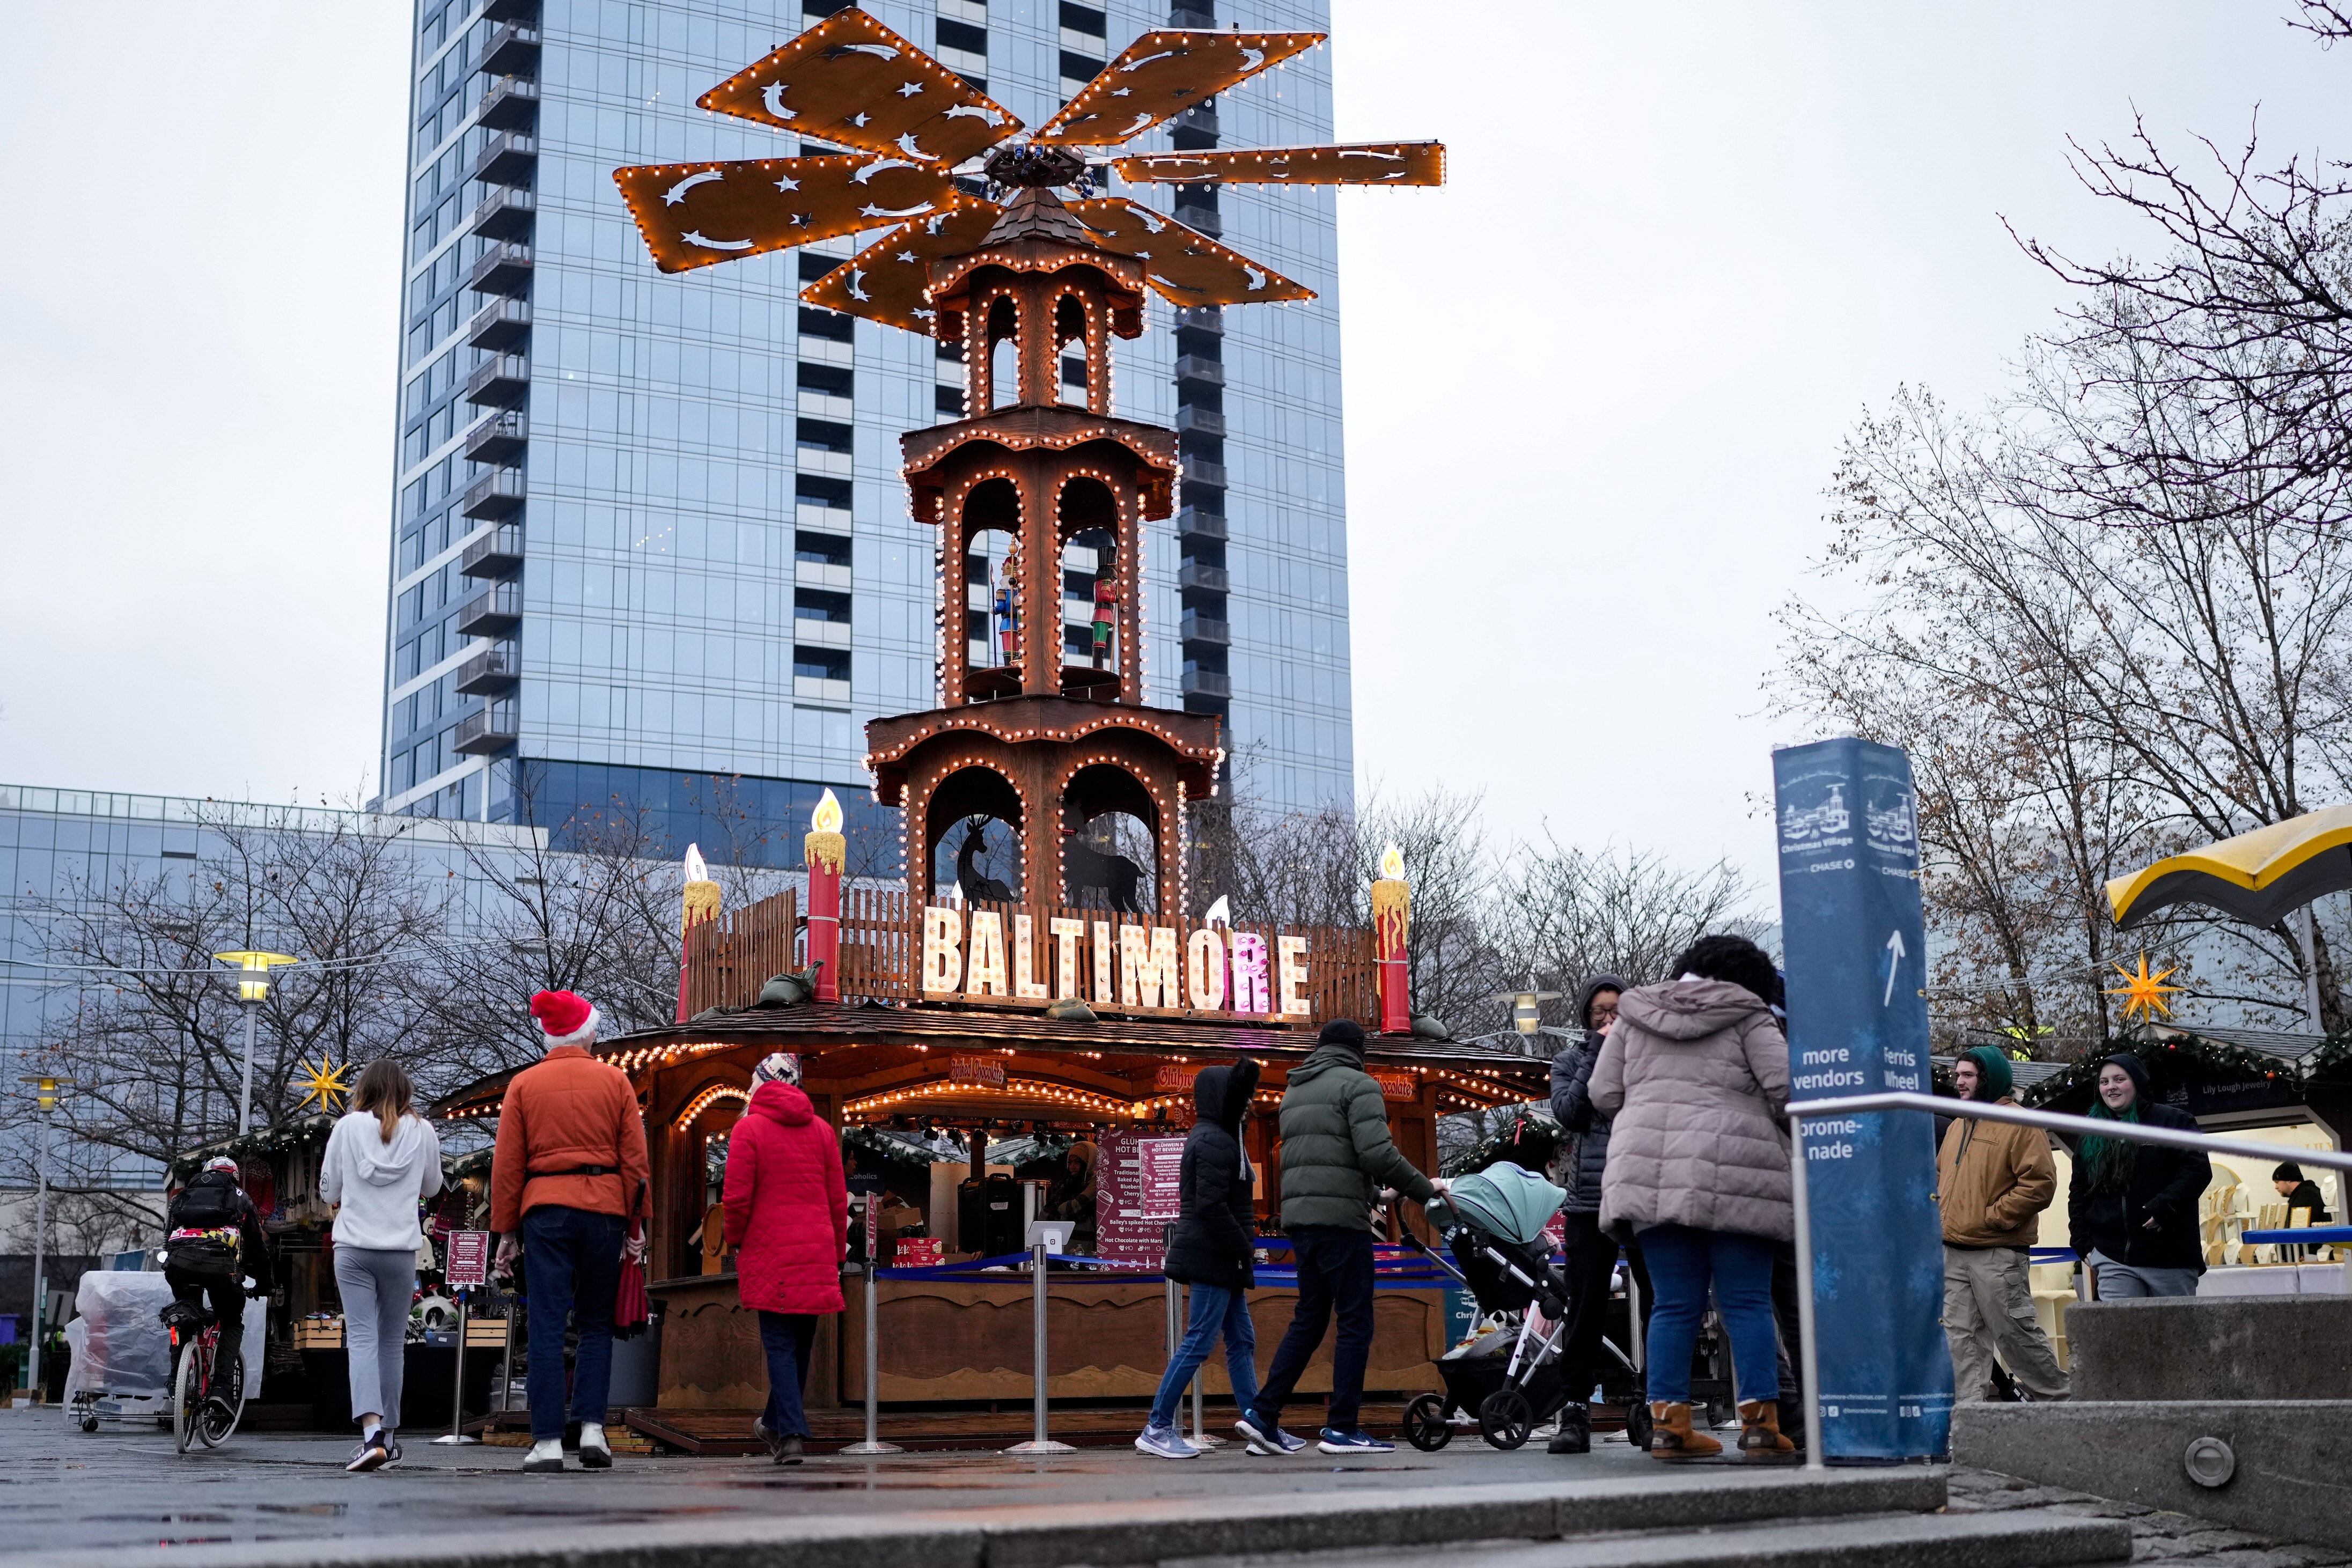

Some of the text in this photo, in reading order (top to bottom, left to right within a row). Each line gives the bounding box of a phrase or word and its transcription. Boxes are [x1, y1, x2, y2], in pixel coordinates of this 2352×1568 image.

[1781, 842, 1822, 853] Christmas
[1822, 837, 1853, 846] Village
[1810, 860, 1843, 873] CHASE
[1881, 867, 1907, 878] CHASE
[922, 906, 1311, 1015] BALTIMORE
[1803, 1048, 1849, 1065] more
[1884, 1046, 1916, 1067] Ferris
[951, 1057, 1004, 1084] Spiked Chocolate
[1792, 1069, 1864, 1089] vendors
[1884, 1070, 1919, 1090] Wheel
[2203, 1080, 2270, 1094] Lily Lough Jewelry
[1809, 1140, 1853, 1160] nade
